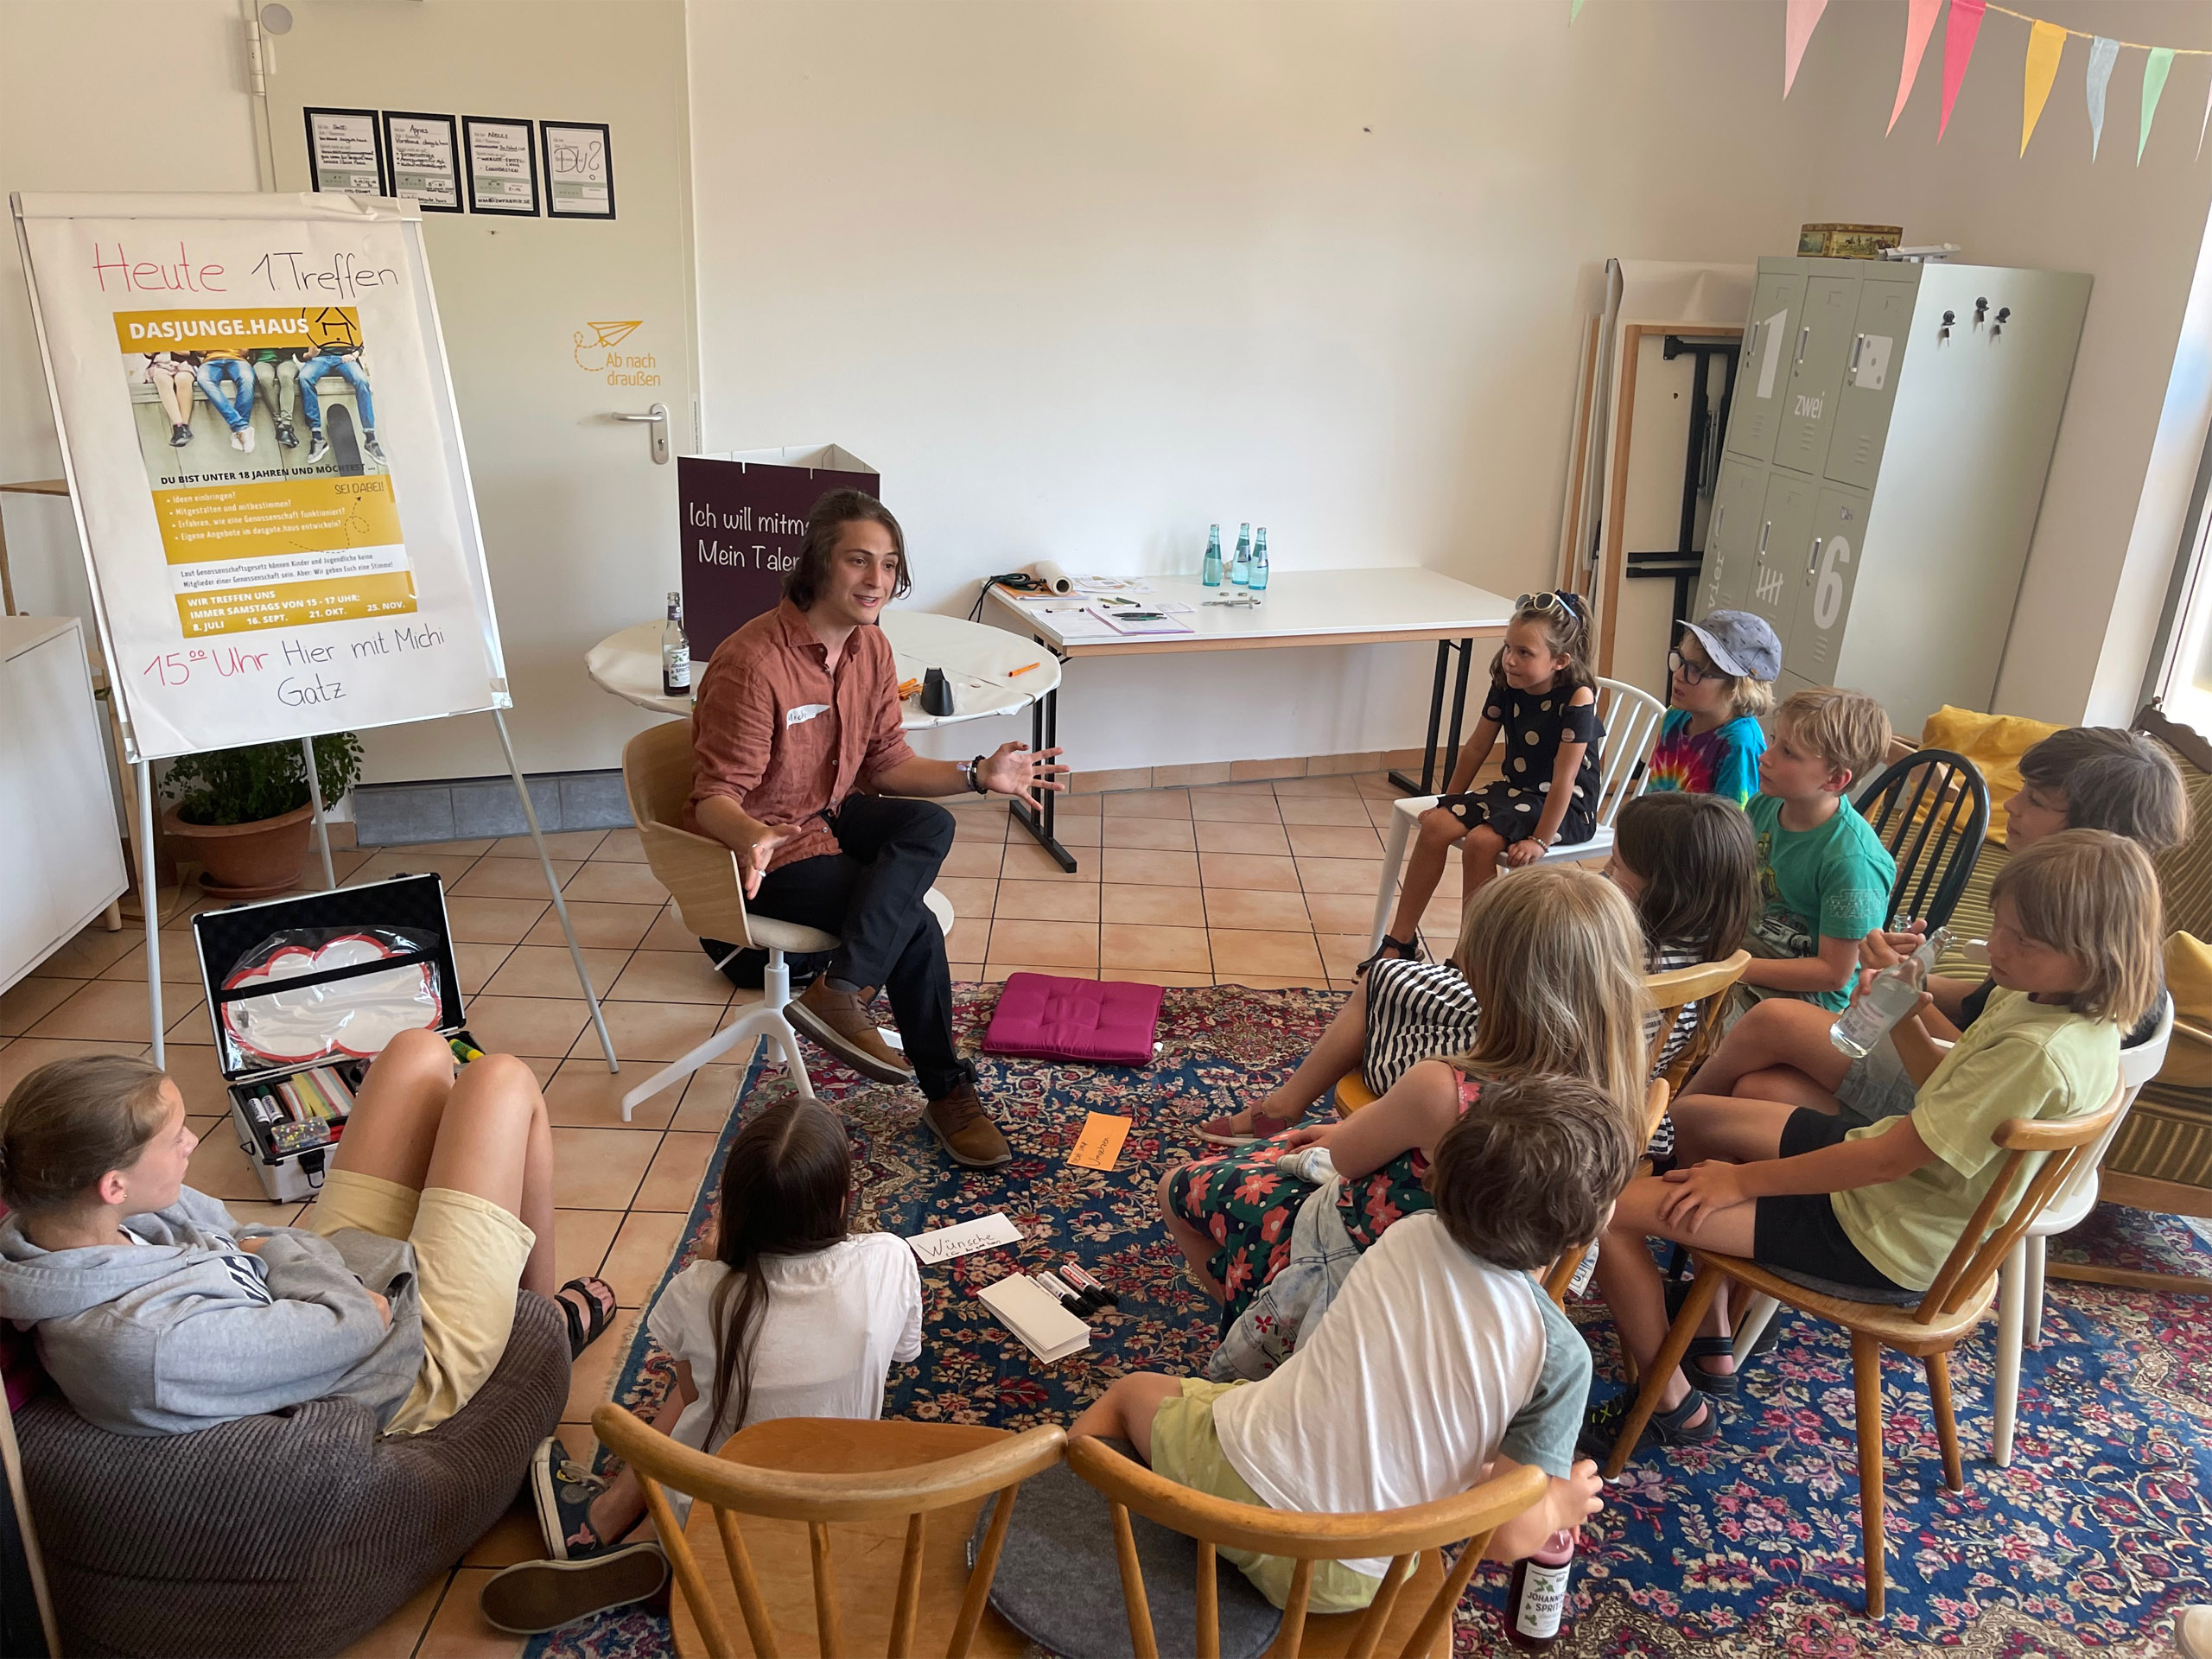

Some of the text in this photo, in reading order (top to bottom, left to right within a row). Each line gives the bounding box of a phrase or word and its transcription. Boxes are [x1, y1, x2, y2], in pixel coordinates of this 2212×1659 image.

[92, 242, 226, 292] Heute
[129, 318, 309, 342] DASJUNGE.HAUS
[607, 353, 655, 368] Ab nach
[1757, 308, 1788, 399] 1
[607, 371, 660, 386] draußen
[1794, 391, 1825, 420] zwei
[178, 474, 200, 484] BIST
[202, 473, 237, 482] UNTER
[252, 469, 289, 480] JAHREN
[292, 467, 314, 476] UND
[316, 463, 365, 474] MÖCHTEST
[173, 492, 236, 504] Ideen einbringen?
[334, 482, 385, 495] SEI DABEI!
[175, 499, 291, 516] Mitgestalten und mitbestimmen?
[245, 512, 299, 523] Genossenschaft
[301, 507, 345, 518] funktioniert?
[690, 502, 716, 528] Ich
[723, 506, 752, 531] will
[181, 532, 205, 542] Eigene
[207, 528, 241, 539] Angebote
[243, 527, 251, 536] im
[302, 520, 341, 531] entwickeln?
[196, 563, 267, 576] Genossenschaftsgesetz
[269, 561, 289, 569] können
[323, 554, 356, 565] Jugendliche
[699, 539, 745, 567] Mein
[183, 579, 214, 588] Mitglieder
[233, 572, 279, 583] Genossenschaft
[325, 566, 342, 575] geben
[371, 561, 393, 569] Stimme!
[1708, 551, 1725, 608] vier
[1814, 536, 1850, 630] 6
[188, 591, 276, 607] WIR TREFFEN UNS
[190, 608, 225, 620] IMMER
[227, 603, 280, 616] SAMSTAGS
[282, 600, 303, 610] VON
[338, 594, 360, 603] UHR:
[193, 623, 202, 632] 8.
[204, 620, 224, 632] JULI
[247, 617, 261, 626] 16.
[263, 613, 288, 624] SEPT.
[325, 608, 346, 617] OKT.
[367, 604, 380, 613] 25.
[382, 601, 405, 611] NOV.
[213, 647, 269, 677] Uhr
[282, 640, 334, 666] Hier
[351, 632, 389, 659] mit
[395, 623, 445, 652] Michi
[277, 674, 346, 706] Gatz
[917, 1234, 995, 1256] Wünsche
